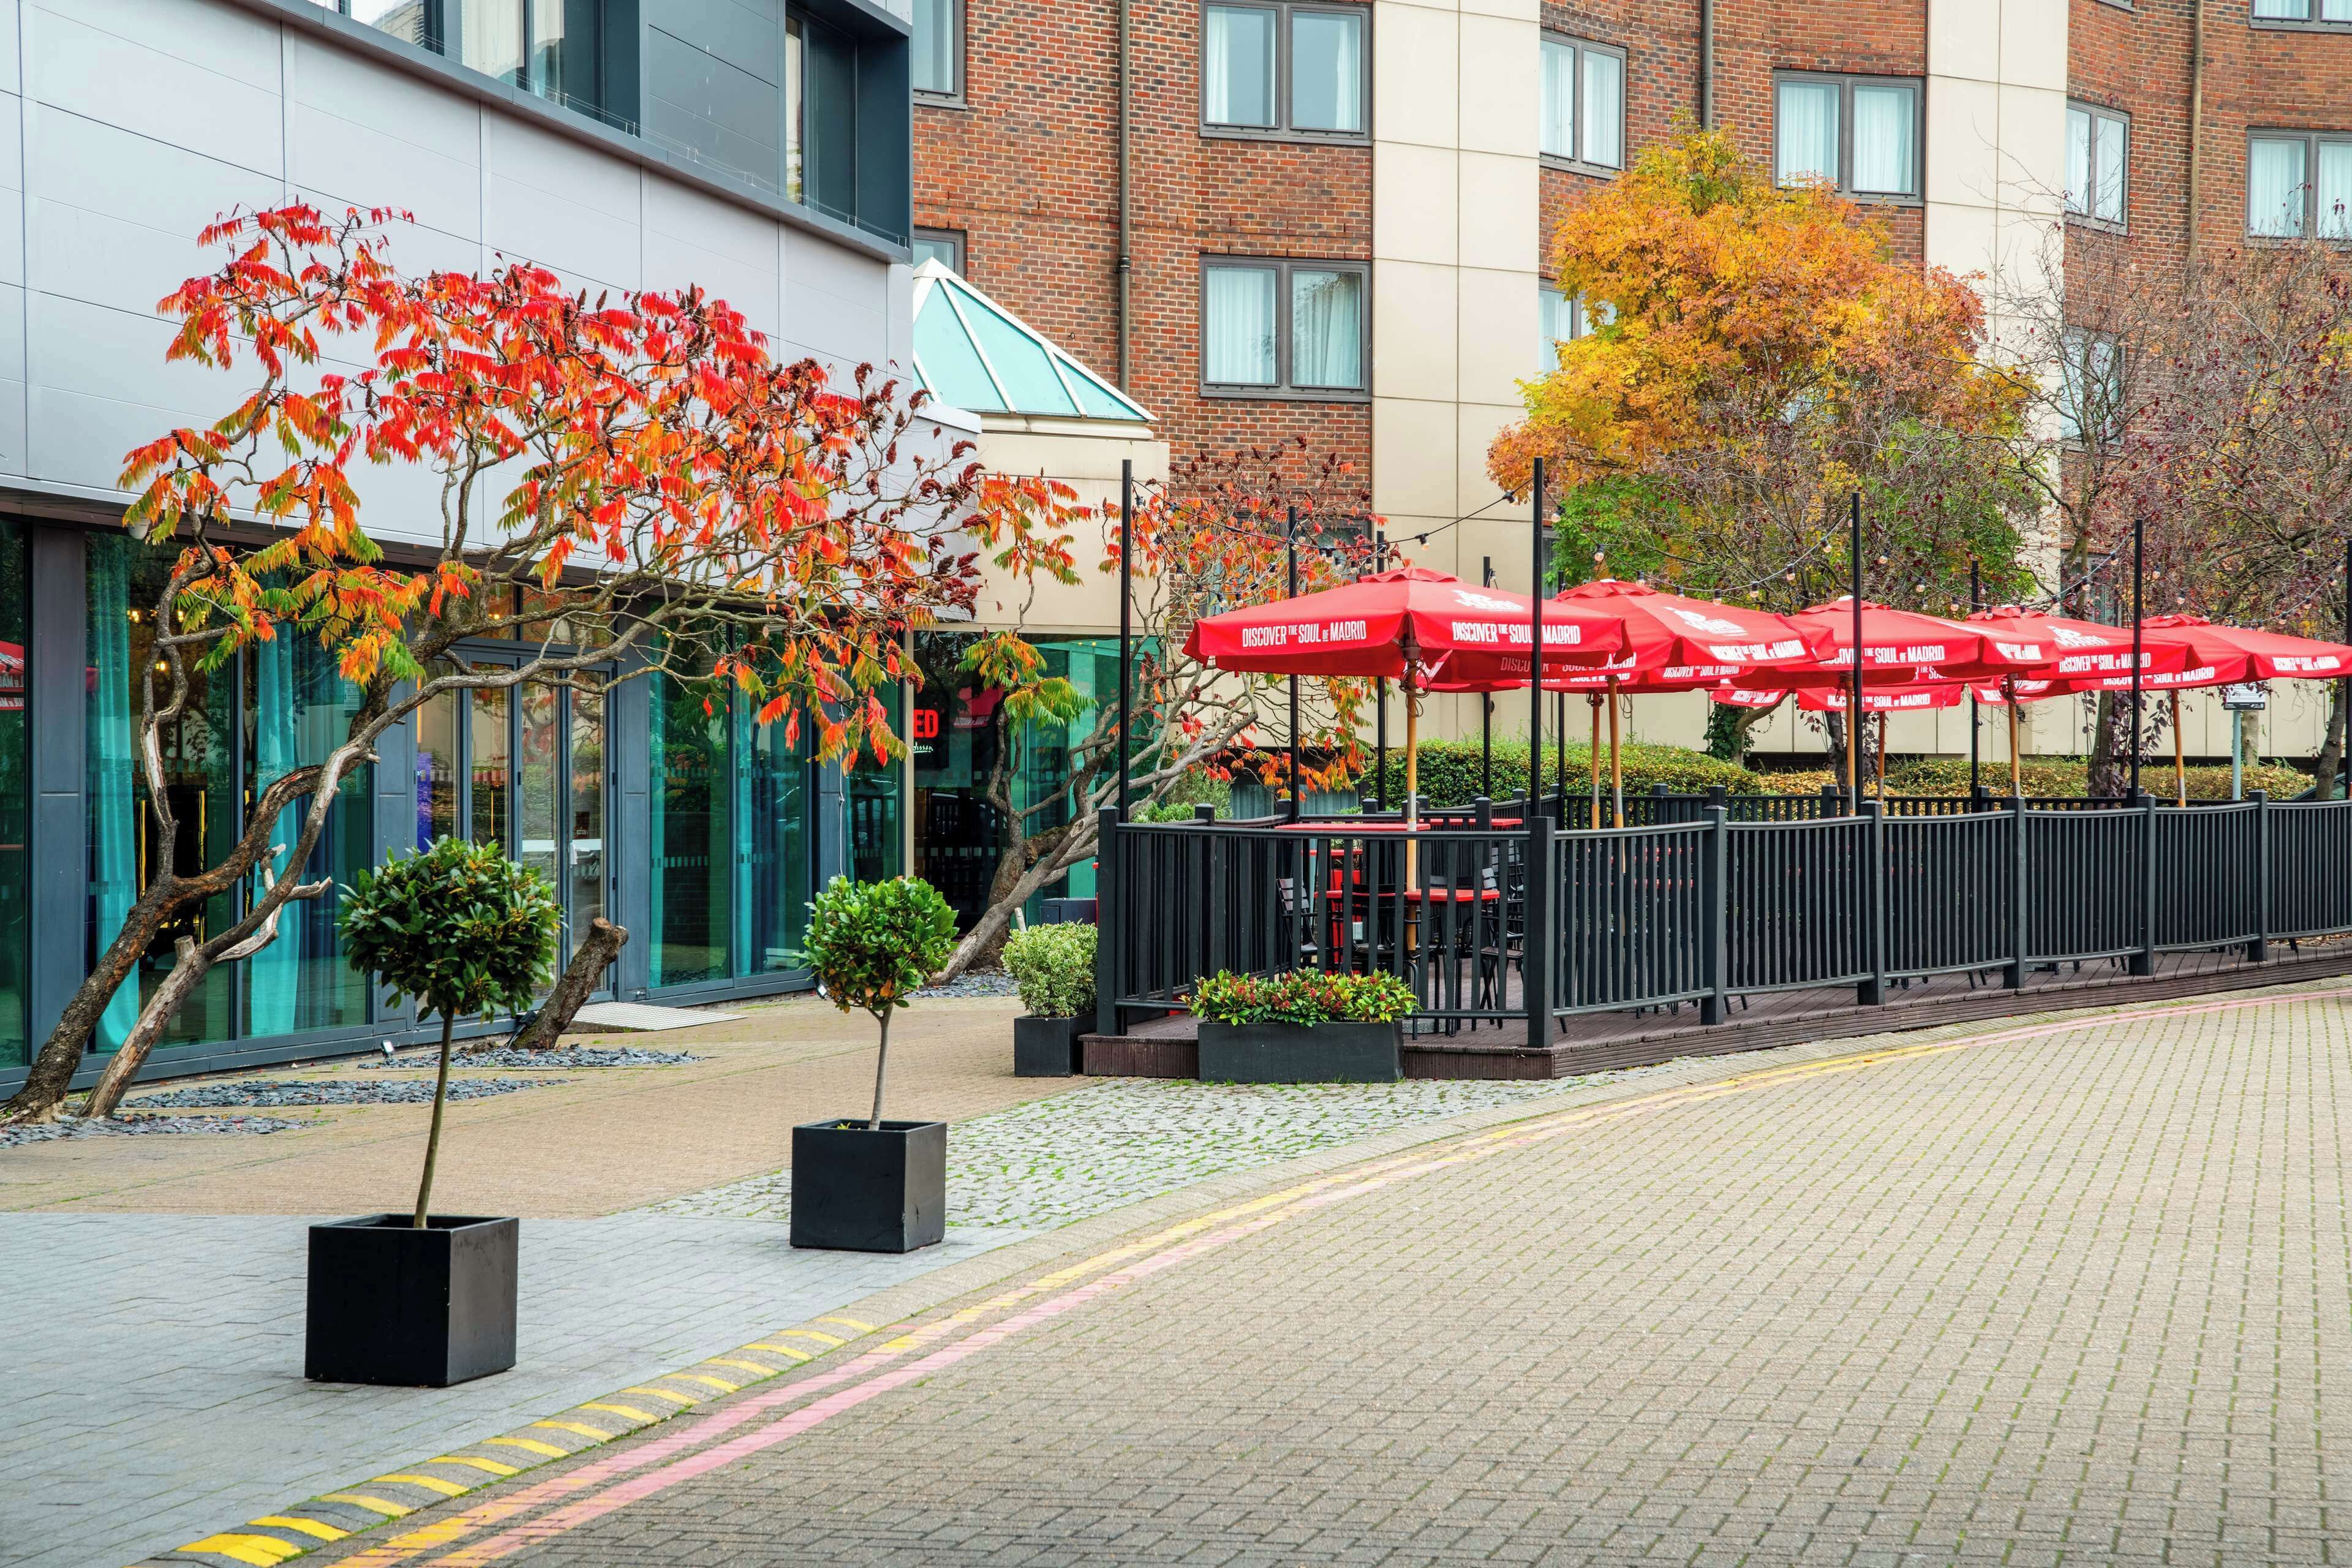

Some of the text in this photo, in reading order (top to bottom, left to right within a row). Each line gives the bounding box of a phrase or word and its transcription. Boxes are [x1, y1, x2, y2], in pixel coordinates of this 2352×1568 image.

[1242, 620, 1366, 647] DISCOVER THE SOUL OF MADRID
[1452, 622, 1581, 644] DISCOVER THE SOUL MADRID
[1864, 647, 1874, 657] THE
[1875, 647, 1899, 663] SOUL
[1900, 652, 1907, 662] OF
[1907, 645, 1945, 662] MADRID
[2098, 654, 2116, 670] SOUL
[2182, 666, 2215, 682] MADRID
[1874, 695, 1893, 707] SOUL
[1900, 693, 1930, 706] MADRID
[913, 709, 938, 737] ED
